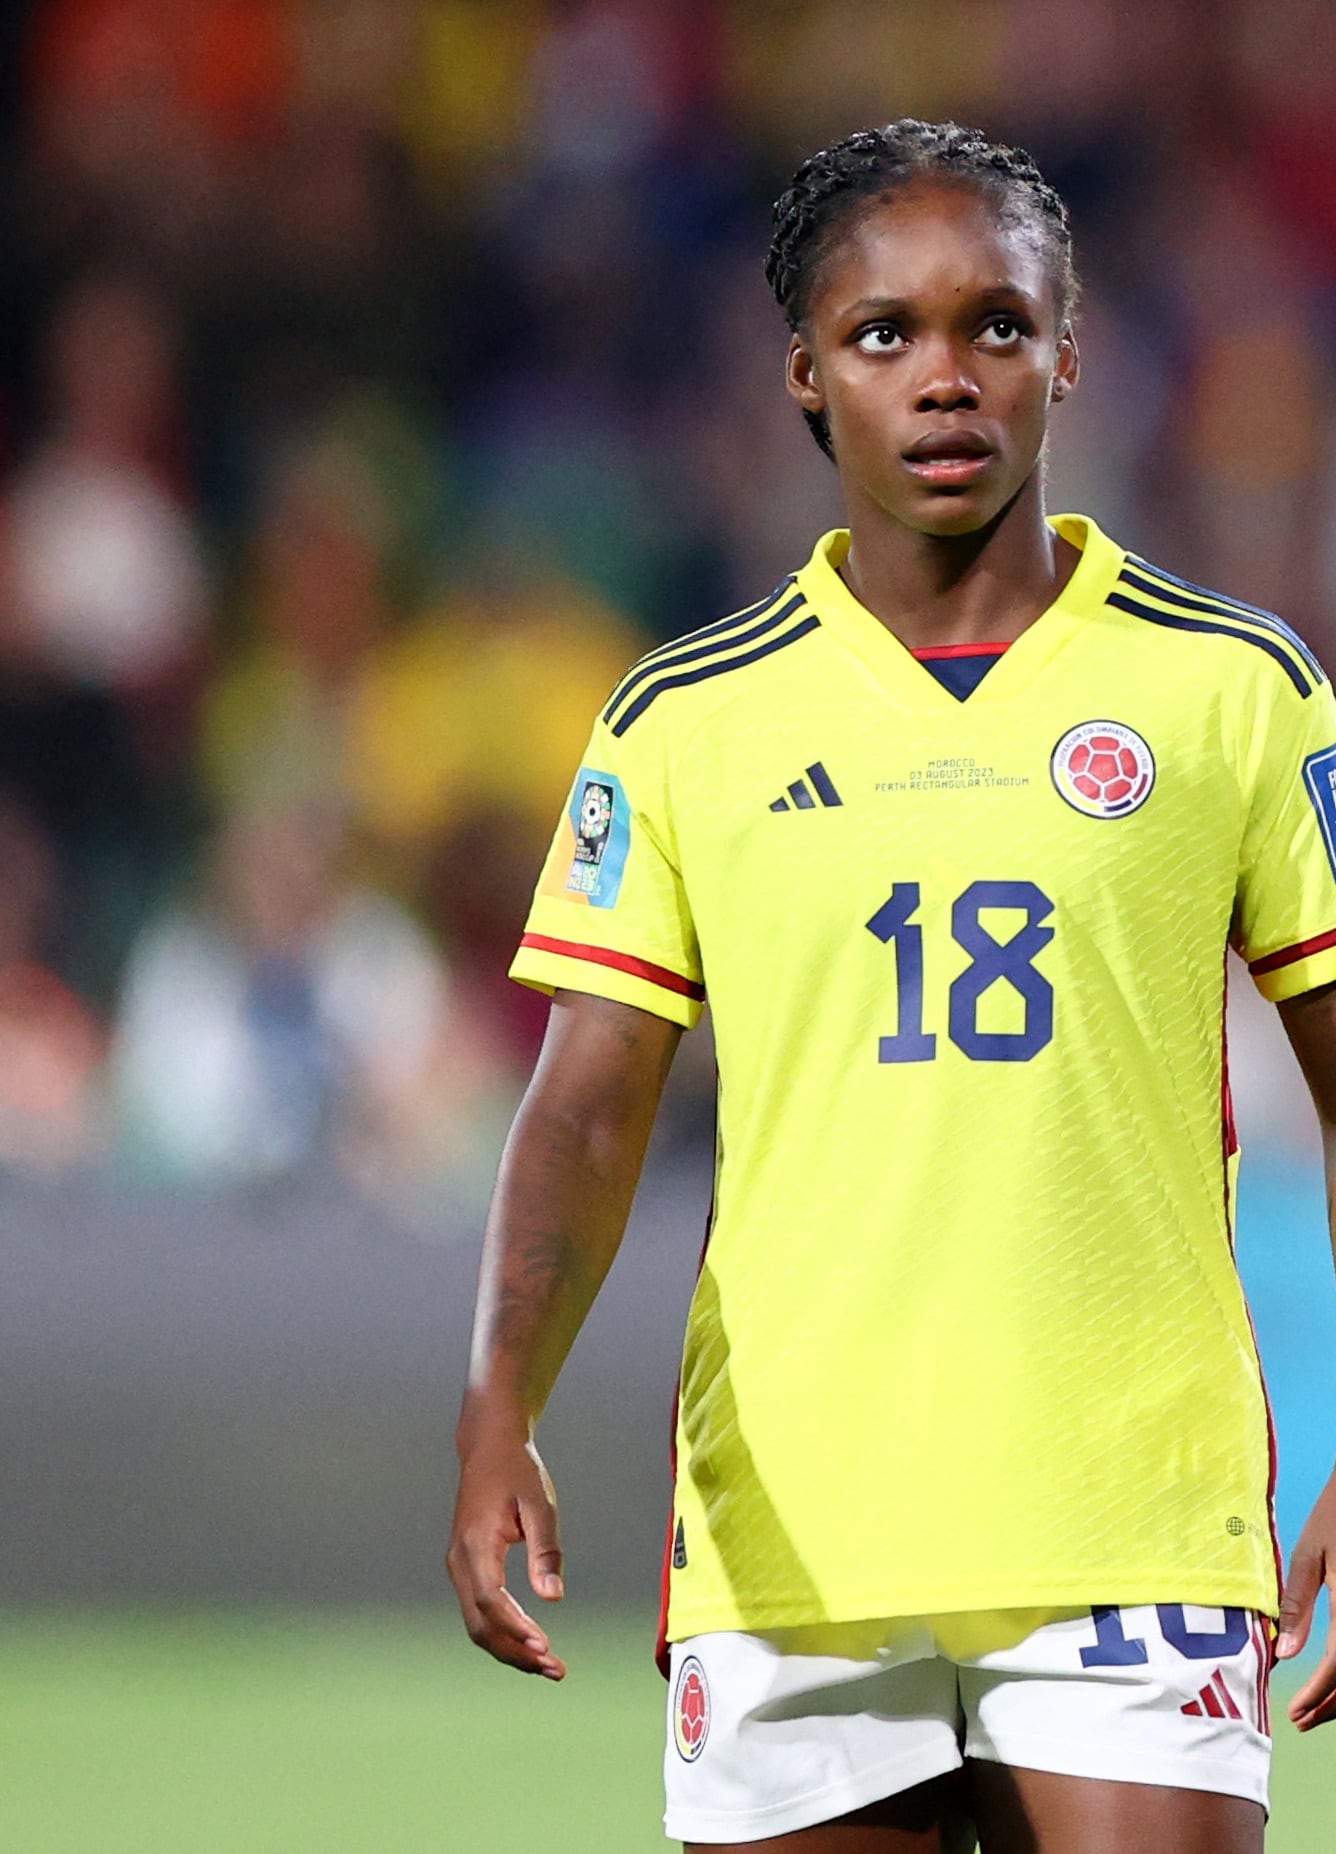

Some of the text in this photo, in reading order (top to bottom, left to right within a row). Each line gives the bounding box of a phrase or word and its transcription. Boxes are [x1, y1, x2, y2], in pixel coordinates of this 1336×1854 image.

[927, 758, 976, 769] MOROCCO
[909, 767, 994, 780] 03 AUGUST 2023
[874, 777, 1030, 792] PERTH RECTANGULAR STADIUM
[865, 880, 1056, 1064] 18
